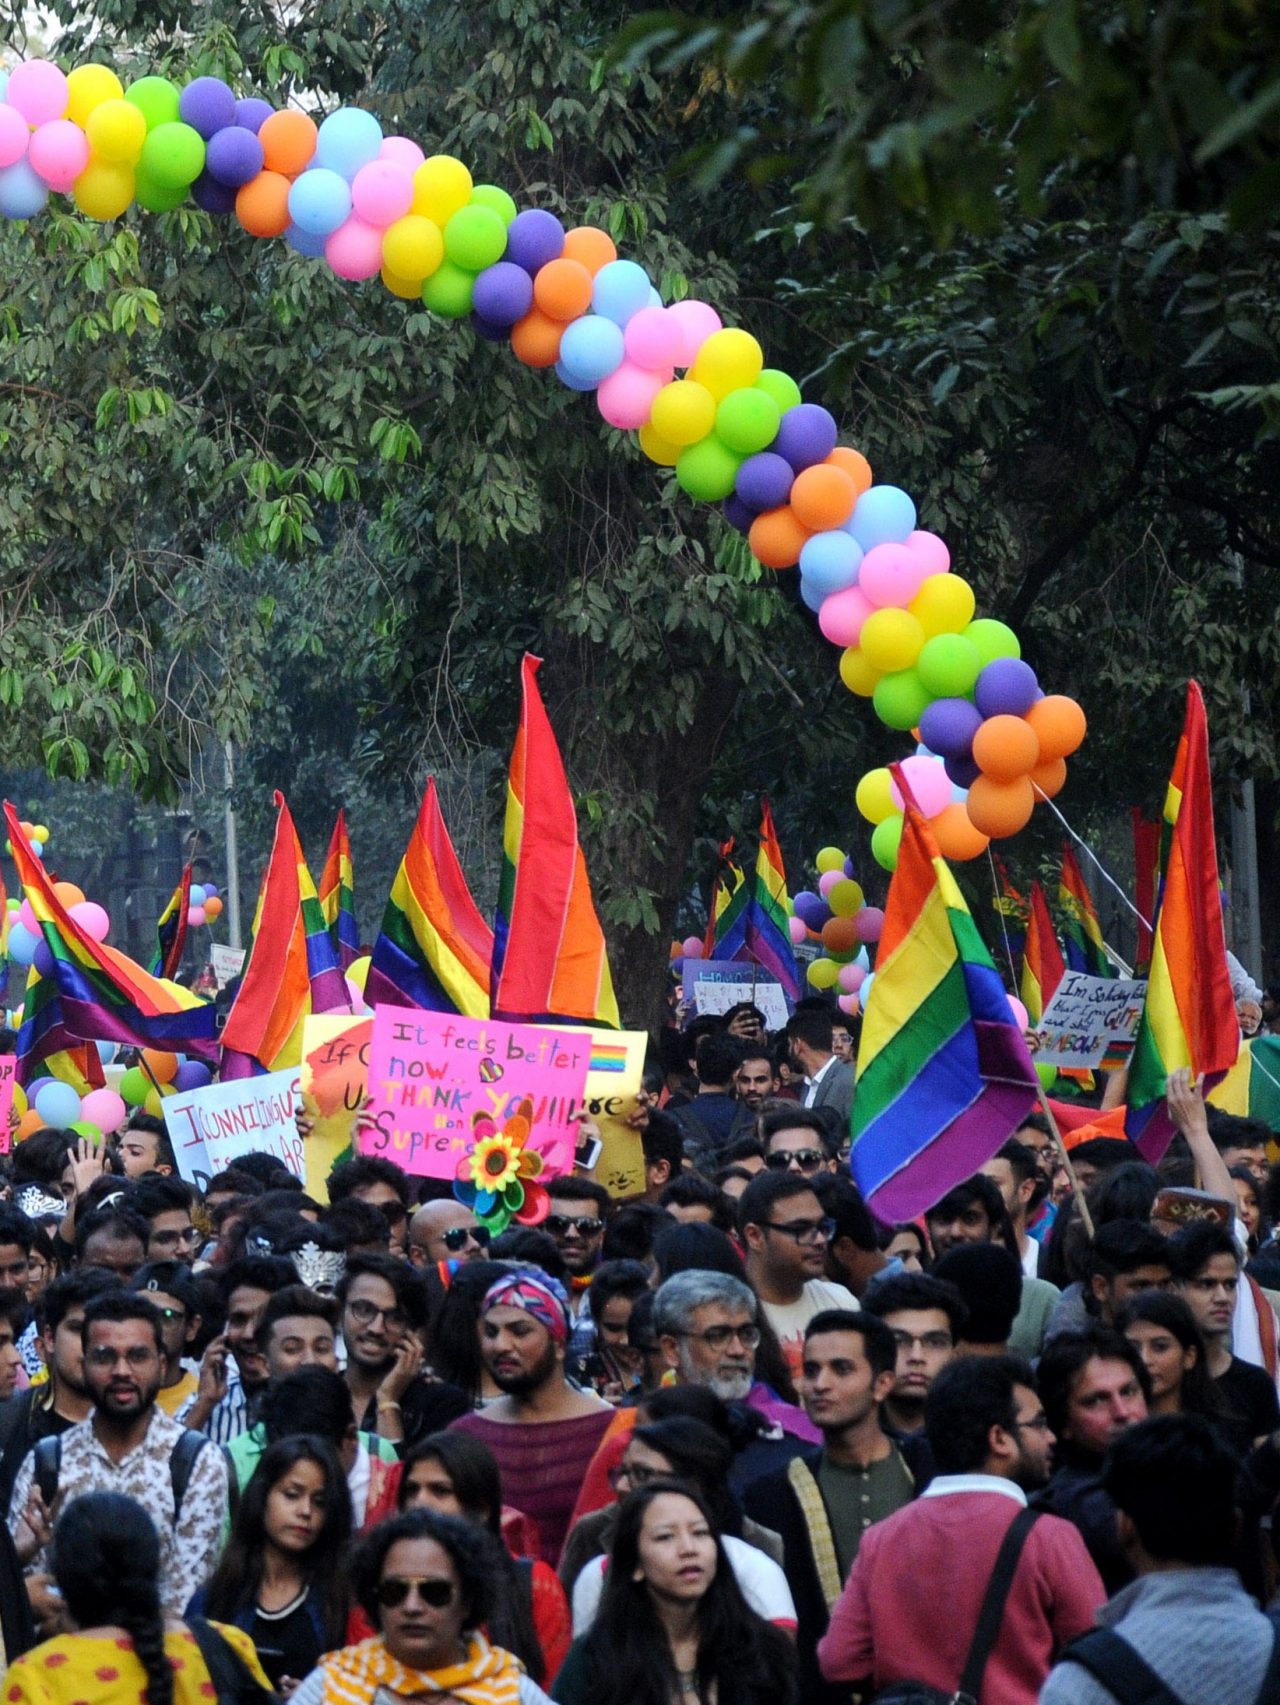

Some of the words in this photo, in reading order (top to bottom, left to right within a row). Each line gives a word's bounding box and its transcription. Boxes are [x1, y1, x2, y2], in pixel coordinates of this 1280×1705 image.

[392, 1022, 428, 1046] It
[441, 1025, 497, 1055] feels
[506, 1032, 581, 1070] better
[382, 1080, 473, 1114] THANK
